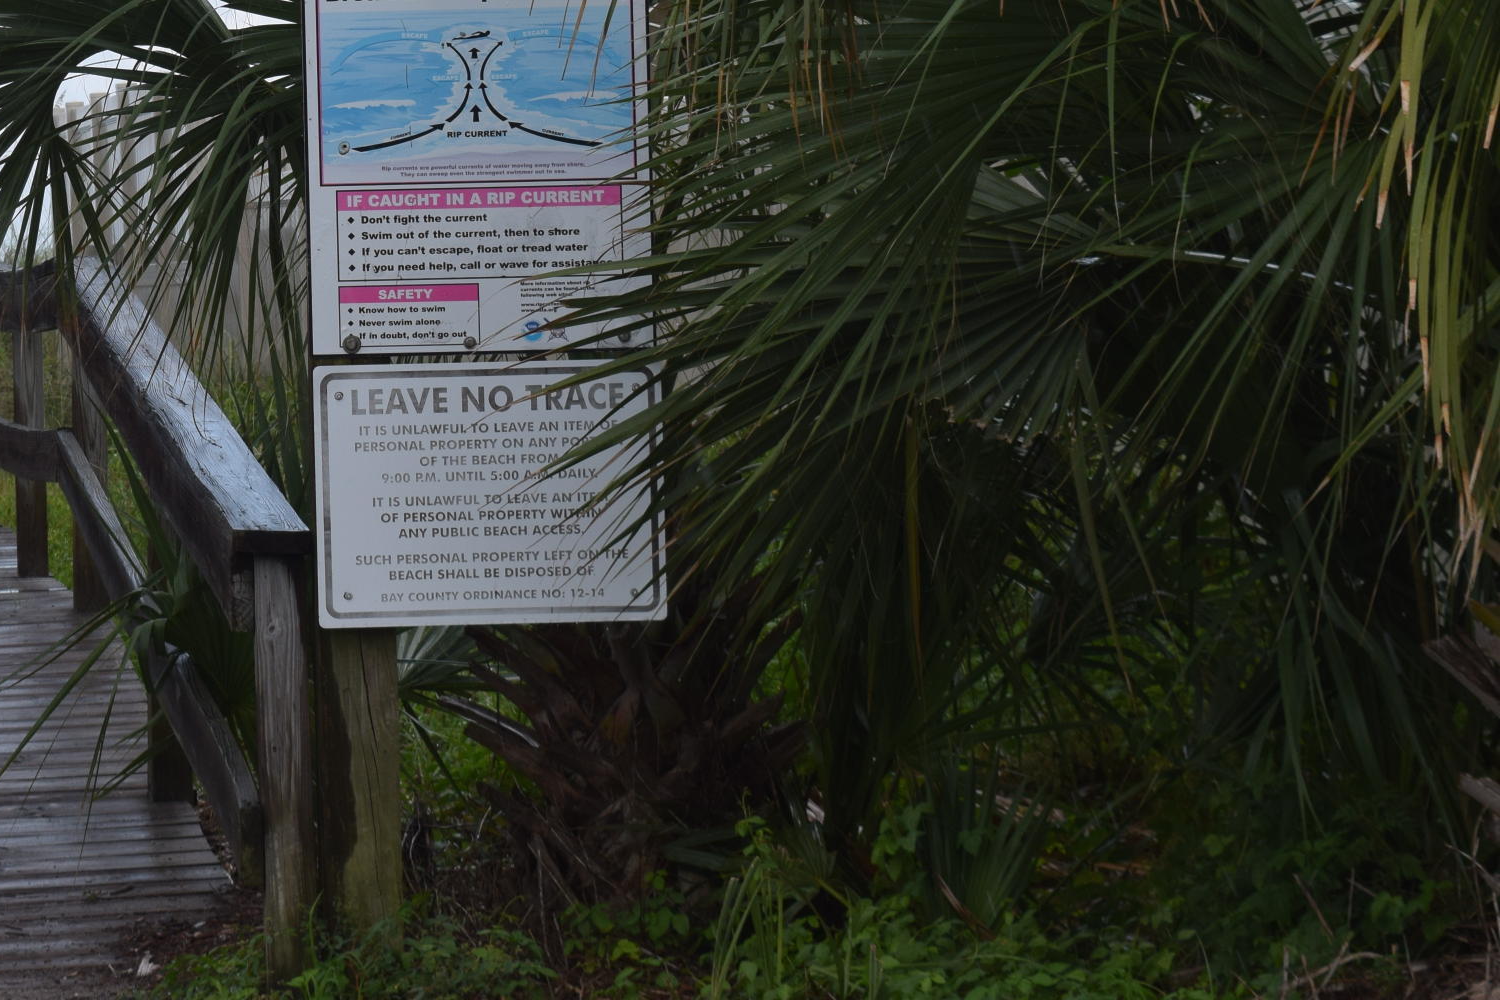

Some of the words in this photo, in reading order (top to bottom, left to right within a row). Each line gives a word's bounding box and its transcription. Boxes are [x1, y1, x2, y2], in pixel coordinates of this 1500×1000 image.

[464, 130, 508, 138] CURRENT
[346, 195, 363, 207] IF
[368, 193, 441, 207] CAUGHT
[446, 193, 464, 205] IN
[470, 192, 482, 205] A
[487, 191, 516, 205] RIP
[521, 190, 604, 204] CURRENT
[361, 215, 390, 224] Don't
[394, 214, 420, 226] fight
[423, 214, 441, 223] the
[445, 214, 487, 223] current
[361, 231, 392, 240] Swim
[396, 231, 414, 240] out
[418, 230, 429, 239] of
[433, 230, 451, 239] the
[455, 229, 501, 239] current,
[504, 228, 529, 237] then
[533, 228, 545, 237] to
[548, 227, 580, 236] shore
[362, 247, 371, 256] If
[374, 248, 394, 257] you
[397, 246, 426, 255] can't
[429, 246, 474, 256] escape,
[477, 245, 503, 254] float
[522, 244, 551, 252] tread
[555, 244, 588, 252] water
[378, 289, 433, 300] SAFETY
[359, 306, 384, 314] Know
[421, 305, 446, 313] swim
[351, 387, 448, 415] LEAVE
[461, 385, 513, 412] NO
[525, 383, 625, 411] TRACE
[359, 426, 370, 436] IT
[375, 425, 387, 436] IS
[392, 424, 465, 436] UNLAWFUL
[471, 423, 489, 434] TO
[494, 421, 534, 433] LEAVE
[539, 421, 559, 432] AN
[564, 420, 595, 431] ITEM
[355, 440, 425, 452] PERSONAL
[430, 439, 497, 450] PROPERTY
[502, 437, 523, 449] ON
[529, 437, 556, 448] ANY
[420, 456, 437, 467] OF
[442, 455, 467, 466] THE
[472, 454, 515, 465] BEACH
[521, 453, 559, 464] FROM
[381, 472, 411, 484] 9:00
[415, 472, 441, 483] P.M.
[445, 471, 485, 482] UNTIL
[490, 470, 519, 481] 5:00
[559, 468, 598, 479] DAILY.
[381, 513, 399, 523] OF
[403, 511, 474, 523] PERSONAL
[479, 509, 546, 521] PROPERTY
[398, 528, 427, 539] ANY
[432, 527, 480, 538] PUBLIC
[484, 525, 527, 537] BEACH
[389, 570, 433, 581] BEACH
[437, 568, 480, 580] SHALL
[484, 567, 500, 578] BE
[505, 566, 571, 578] DISPOSED
[381, 592, 404, 602] BAY
[408, 591, 459, 602] COUNTY
[463, 589, 537, 601] ORDINANCE
[542, 588, 565, 599] NO:
[570, 588, 605, 598] 12-14
